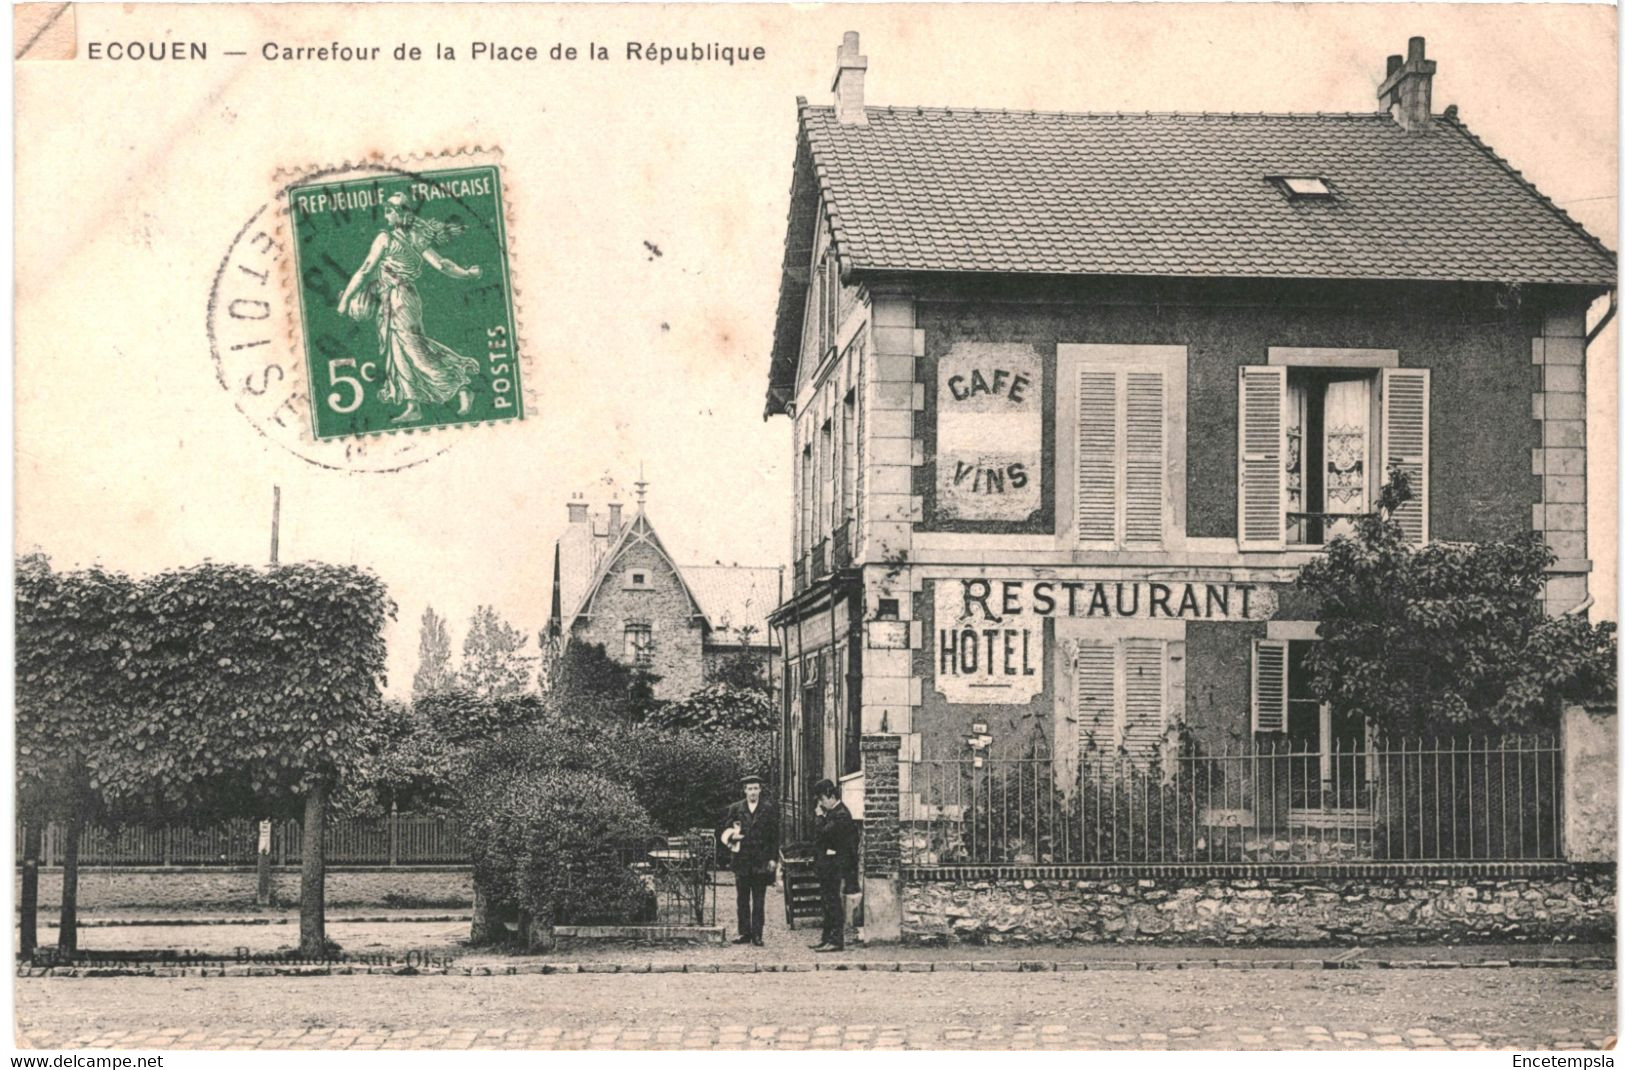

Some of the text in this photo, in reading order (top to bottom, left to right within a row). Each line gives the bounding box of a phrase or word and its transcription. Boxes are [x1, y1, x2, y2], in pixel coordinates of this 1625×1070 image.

[487, 325, 512, 409] POSTES
[947, 369, 1031, 403] CAFÉ
[953, 461, 1028, 494] VINS
[960, 579, 1257, 623] RESTAURANT
[939, 622, 1036, 676] HÔTEL
